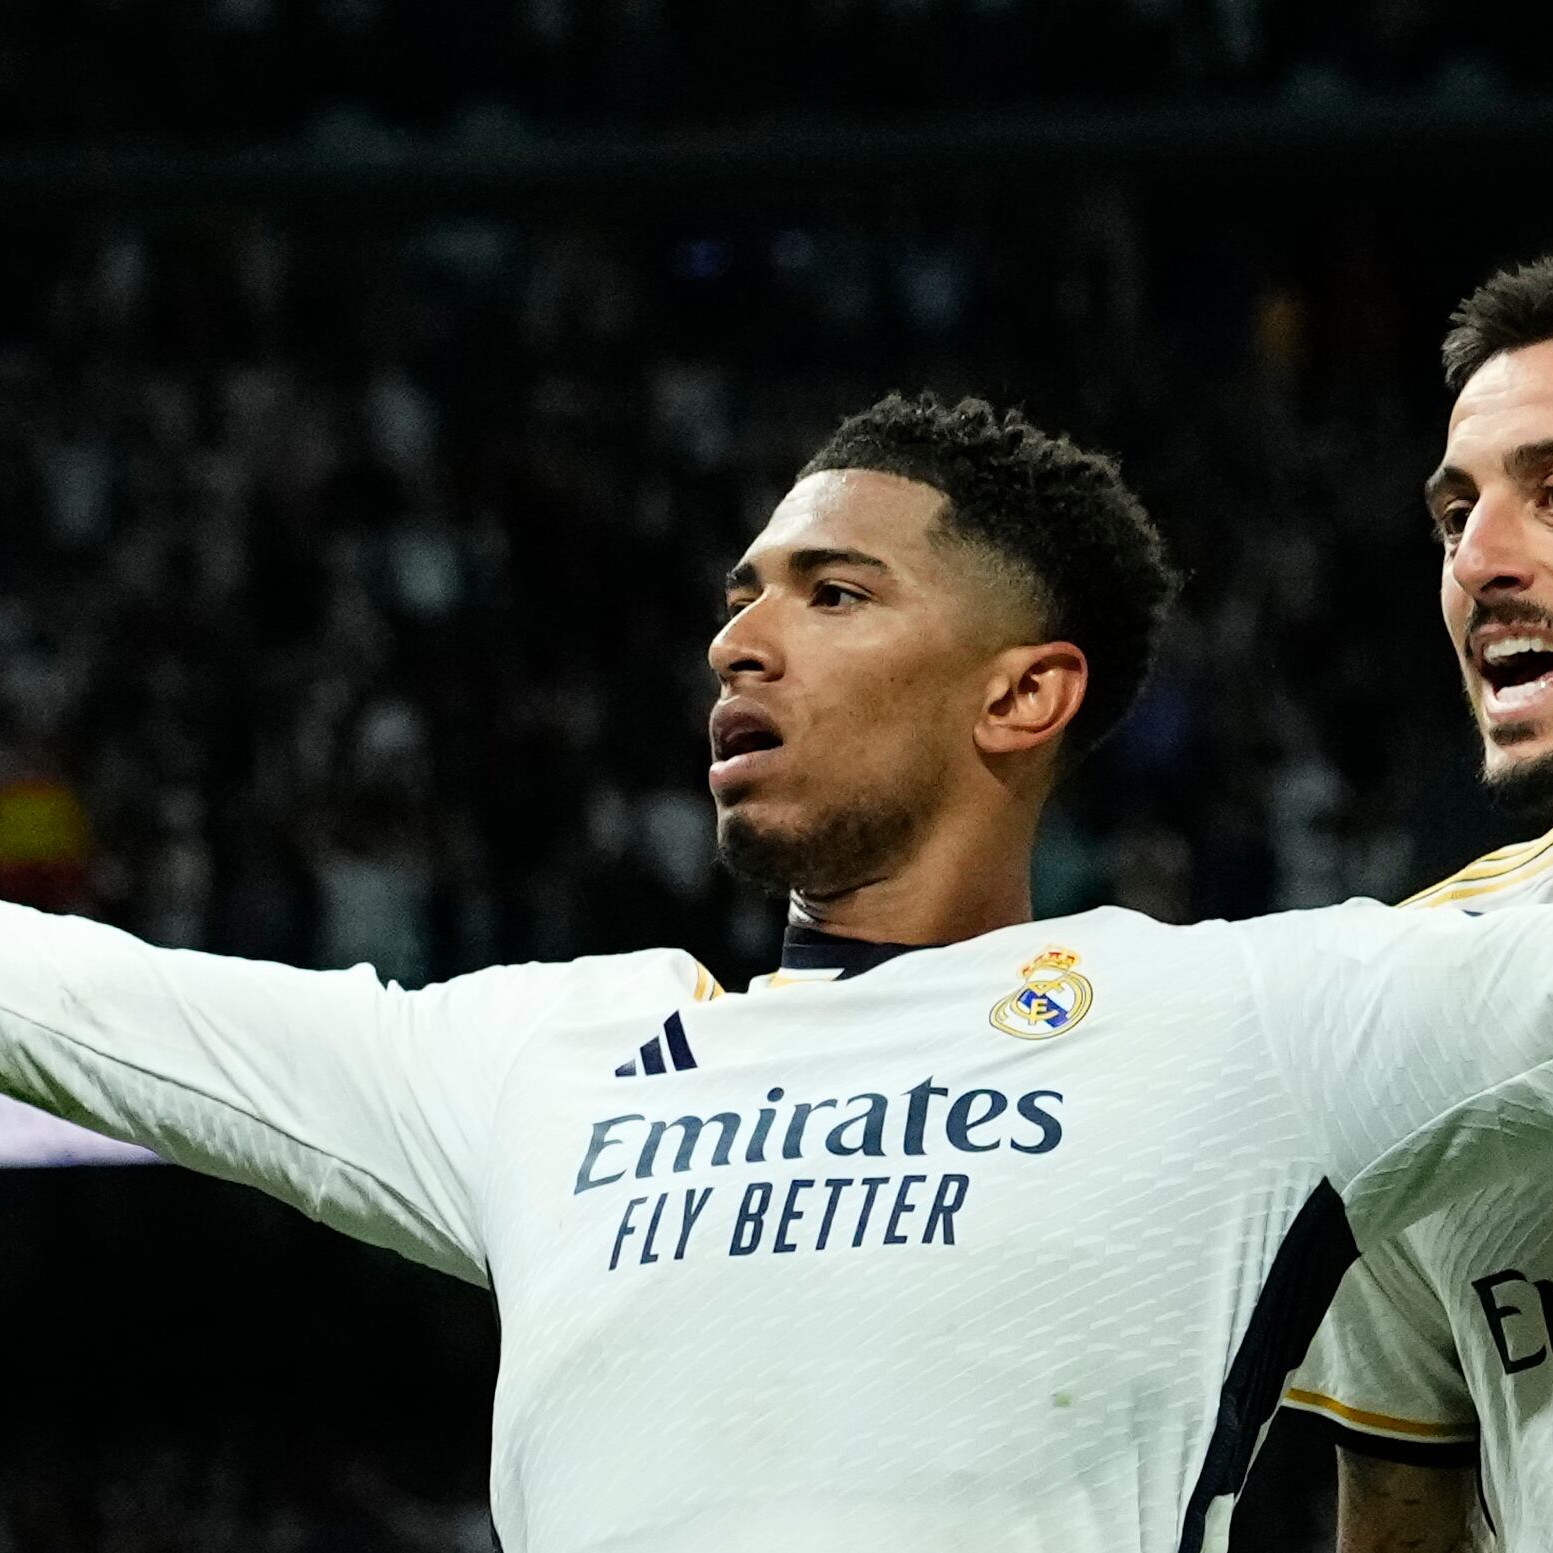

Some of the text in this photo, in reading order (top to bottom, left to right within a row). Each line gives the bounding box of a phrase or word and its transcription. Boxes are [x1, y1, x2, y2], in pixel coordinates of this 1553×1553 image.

[574, 1076, 1064, 1195] Emirates
[608, 1174, 970, 1271] FLY BETTER
